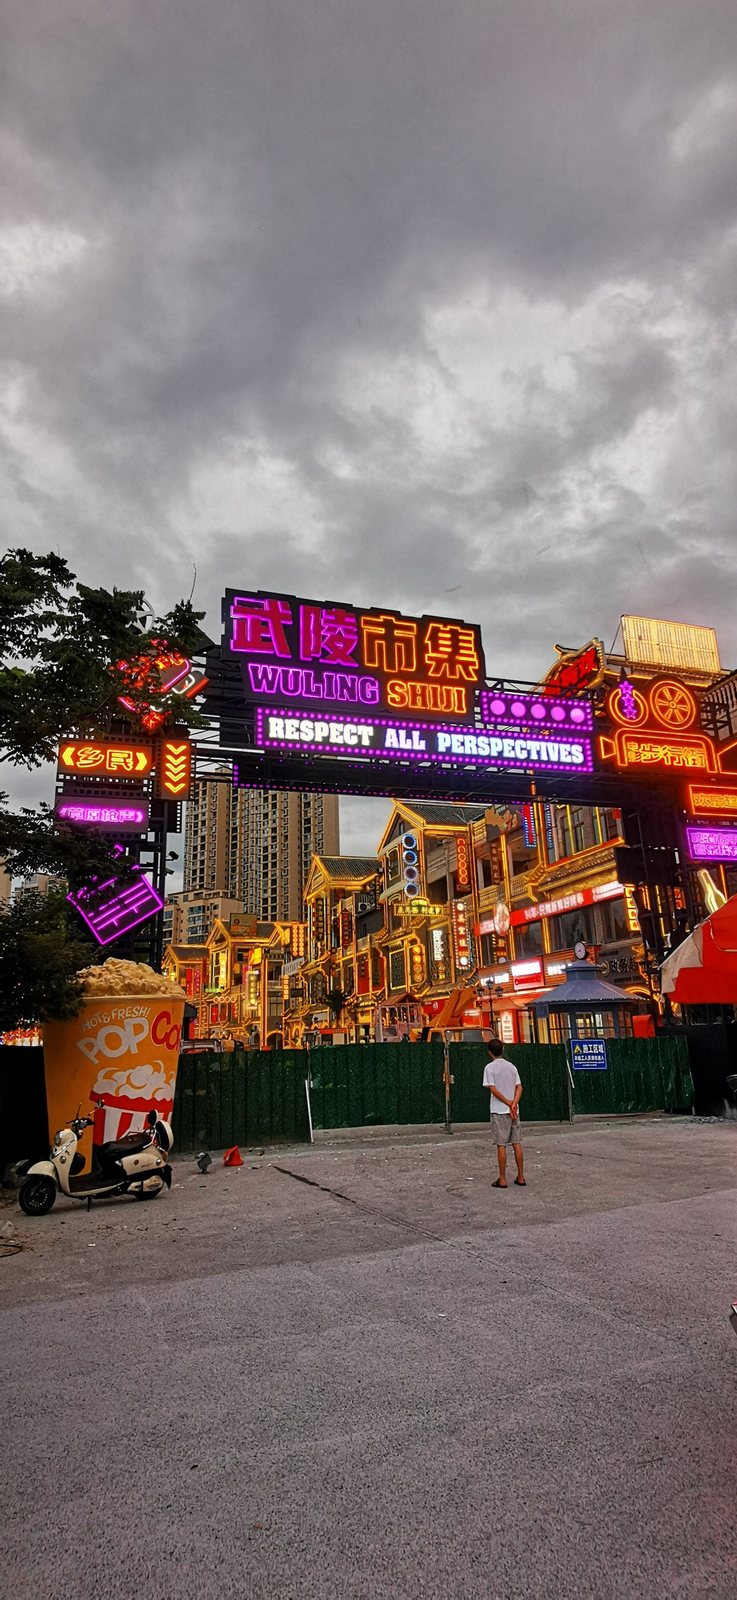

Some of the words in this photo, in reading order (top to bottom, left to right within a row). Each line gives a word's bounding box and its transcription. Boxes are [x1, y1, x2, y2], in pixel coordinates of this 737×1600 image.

[230, 596, 479, 681] 武陵市集
[248, 663, 380, 705] WULING
[386, 680, 467, 714] SHIJI
[268, 716, 374, 747] RESPECT
[384, 727, 426, 751] ALL
[436, 732, 585, 764] PERSPECTIVES
